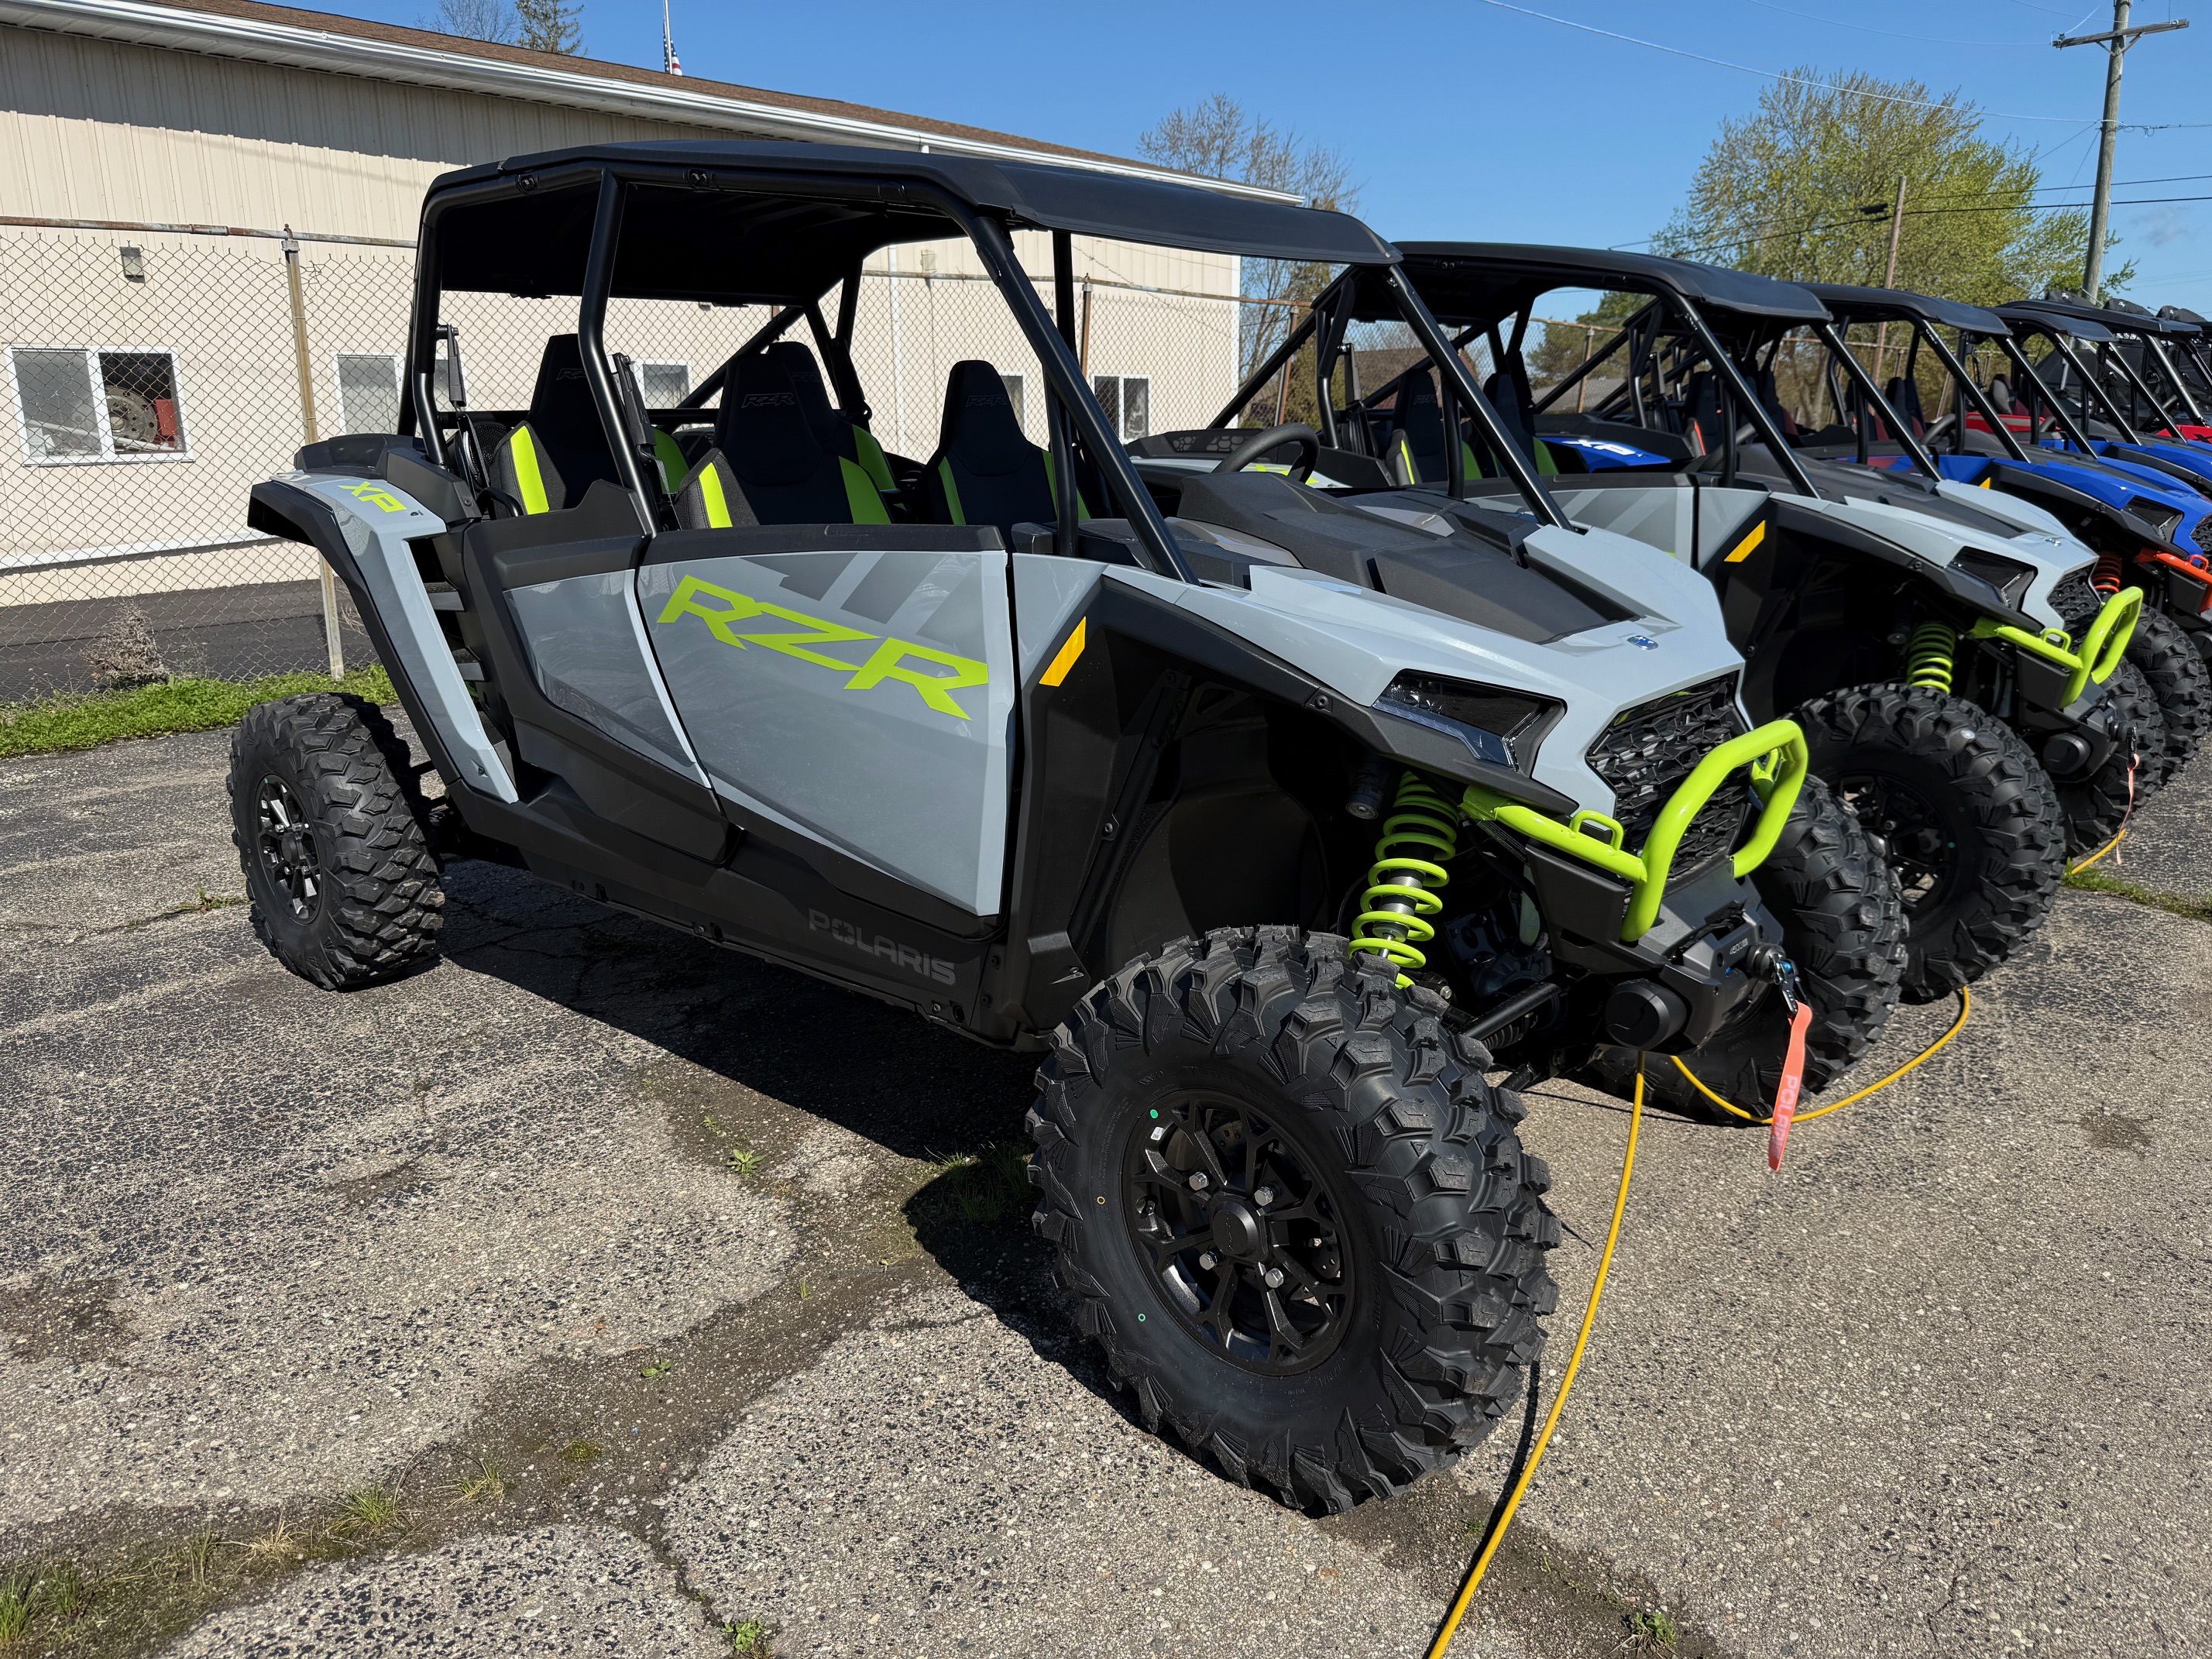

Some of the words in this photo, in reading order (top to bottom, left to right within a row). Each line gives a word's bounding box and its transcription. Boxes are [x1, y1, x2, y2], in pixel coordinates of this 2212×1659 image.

[741, 393, 796, 408] RZR
[965, 393, 1008, 408] RZR
[1561, 438, 1637, 456] XP
[338, 481, 407, 513] XP
[658, 575, 988, 720] RZR
[809, 908, 957, 985] POLARIS
